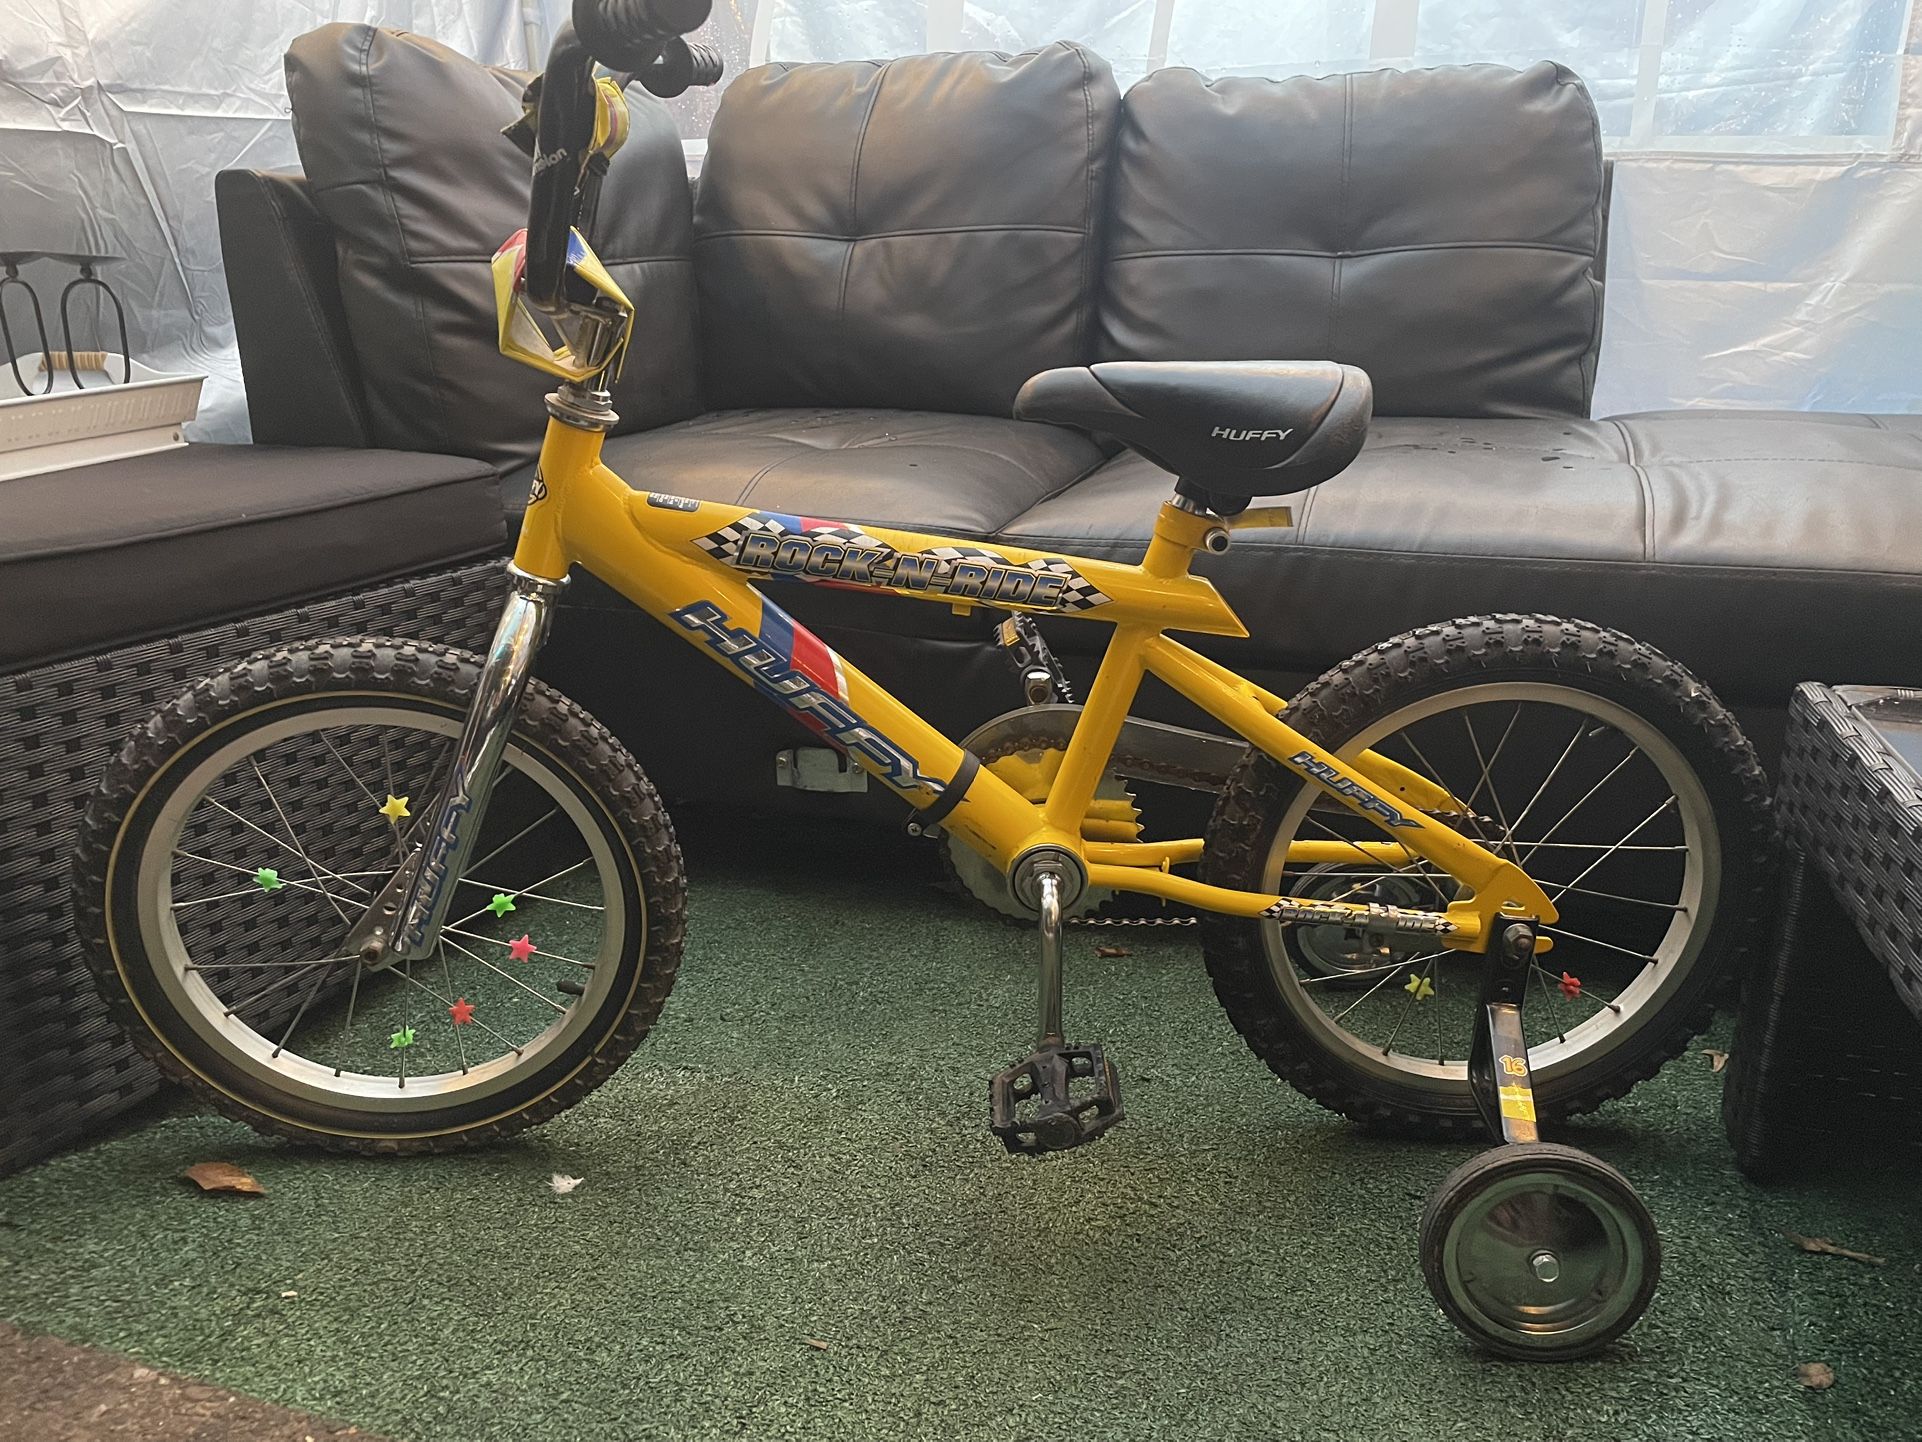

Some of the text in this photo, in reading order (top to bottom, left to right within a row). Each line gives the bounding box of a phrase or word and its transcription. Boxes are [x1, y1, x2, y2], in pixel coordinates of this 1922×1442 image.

[1211, 426, 1293, 441] HUFFY
[738, 530, 1072, 608] ROCK-N-RIDE
[670, 599, 949, 794] HUFFY
[1287, 750, 1427, 829] HUFFY
[1499, 1055, 1528, 1077] 16
